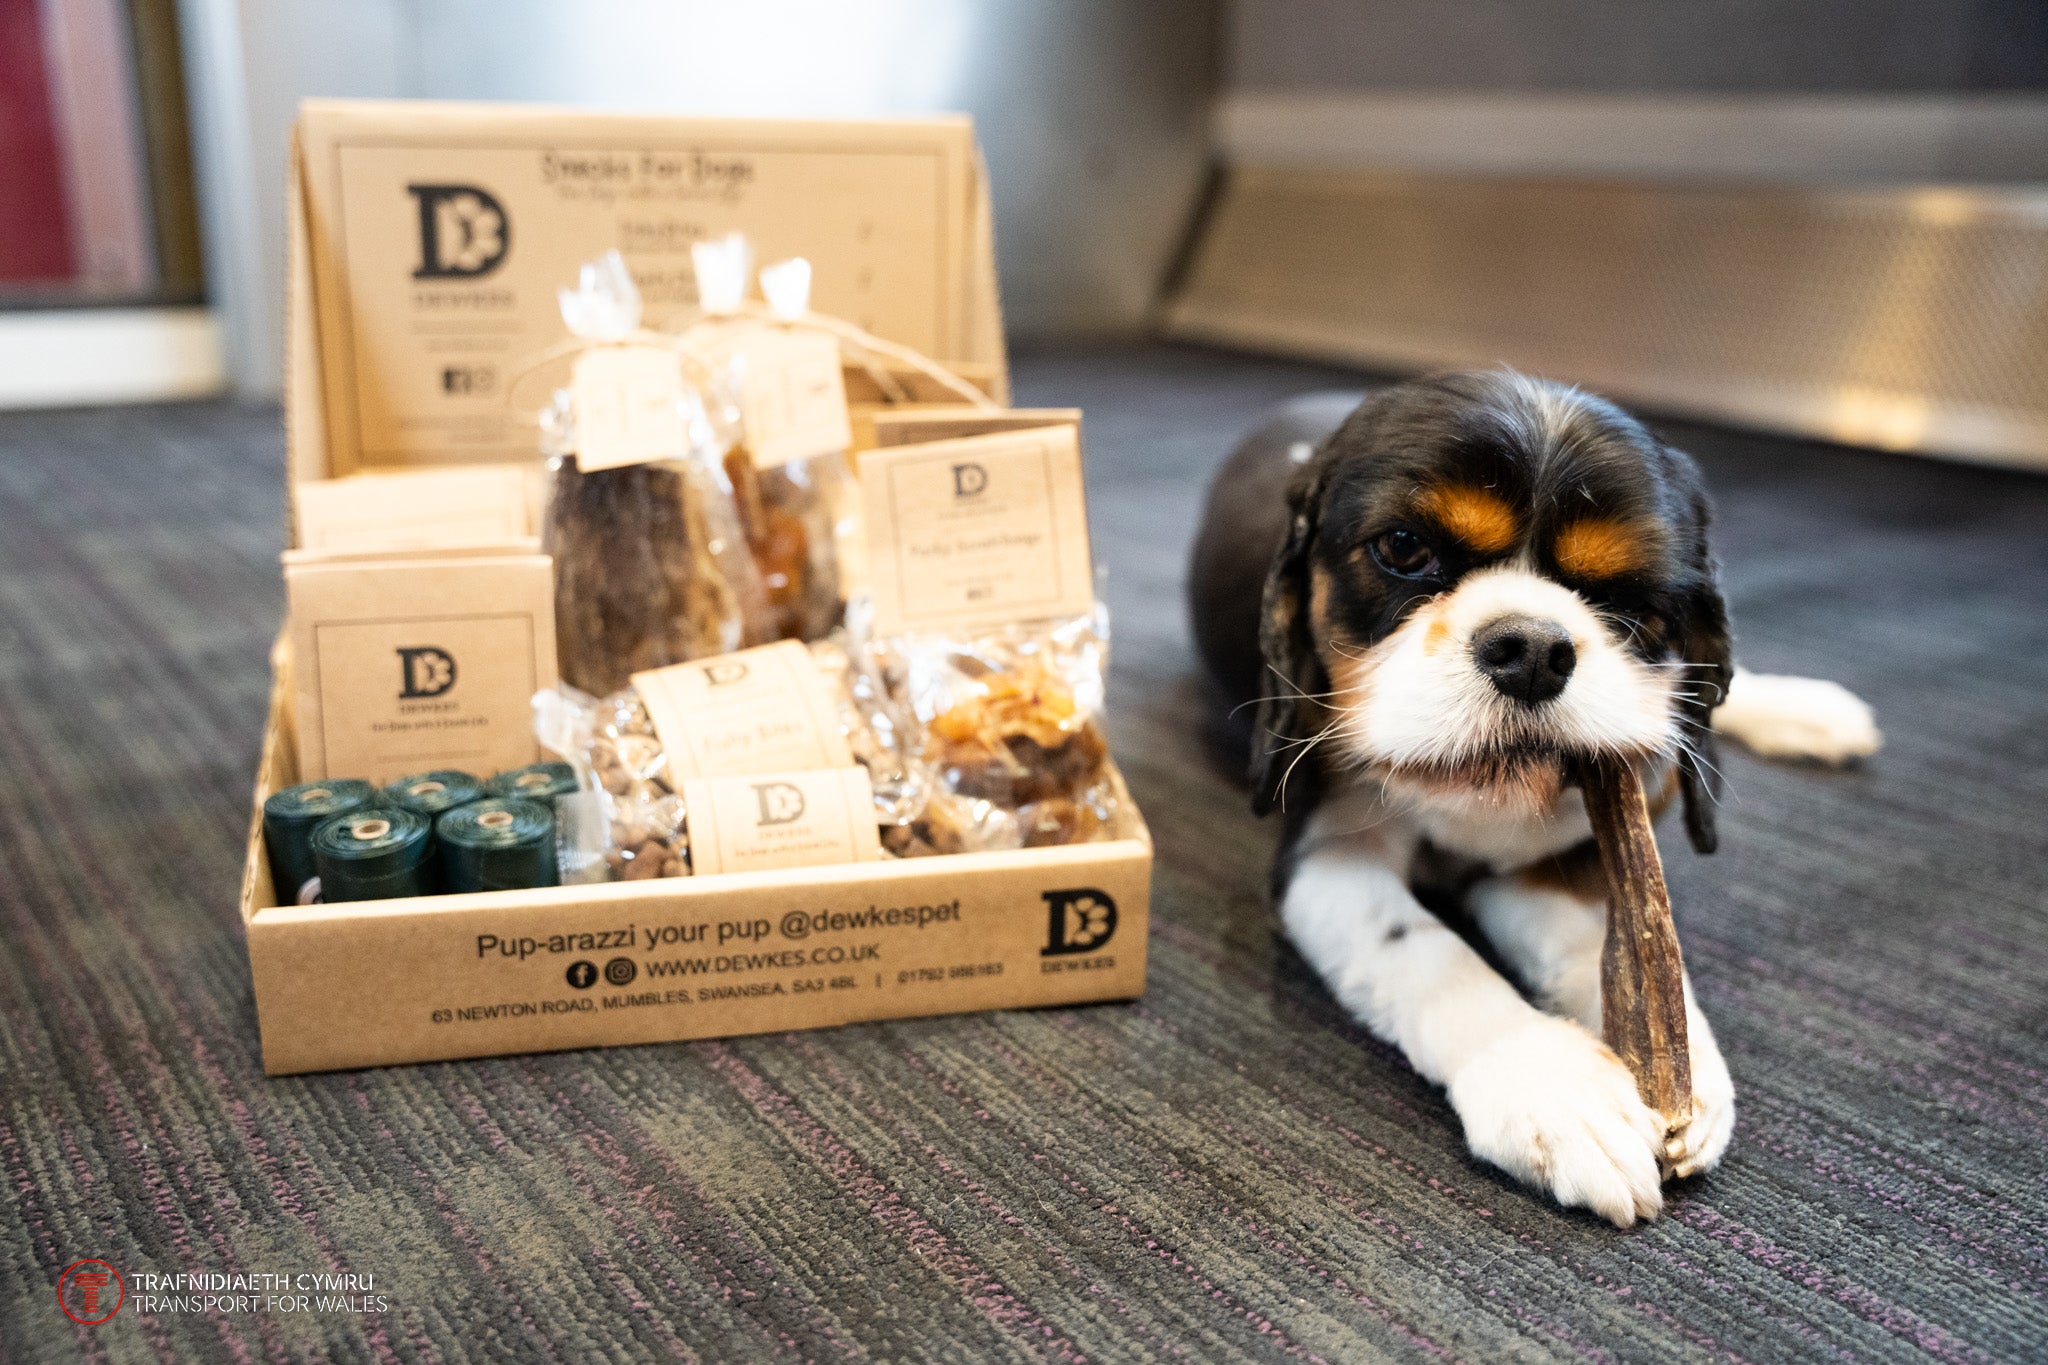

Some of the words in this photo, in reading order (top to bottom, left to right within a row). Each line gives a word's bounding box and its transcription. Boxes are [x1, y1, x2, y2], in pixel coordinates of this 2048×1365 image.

[476, 923, 636, 960] Pup-arazzi
[645, 920, 709, 951] your
[717, 916, 771, 945] pup
[779, 899, 962, 941] @dewkespet
[645, 943, 880, 977] WWW.DEWKES.CO.UK
[1040, 956, 1116, 974] DEWKES
[432, 1009, 454, 1024] 63
[458, 1001, 537, 1022] NEWTON
[541, 997, 599, 1015] ROAD,
[602, 989, 694, 1010] MUMBLES,
